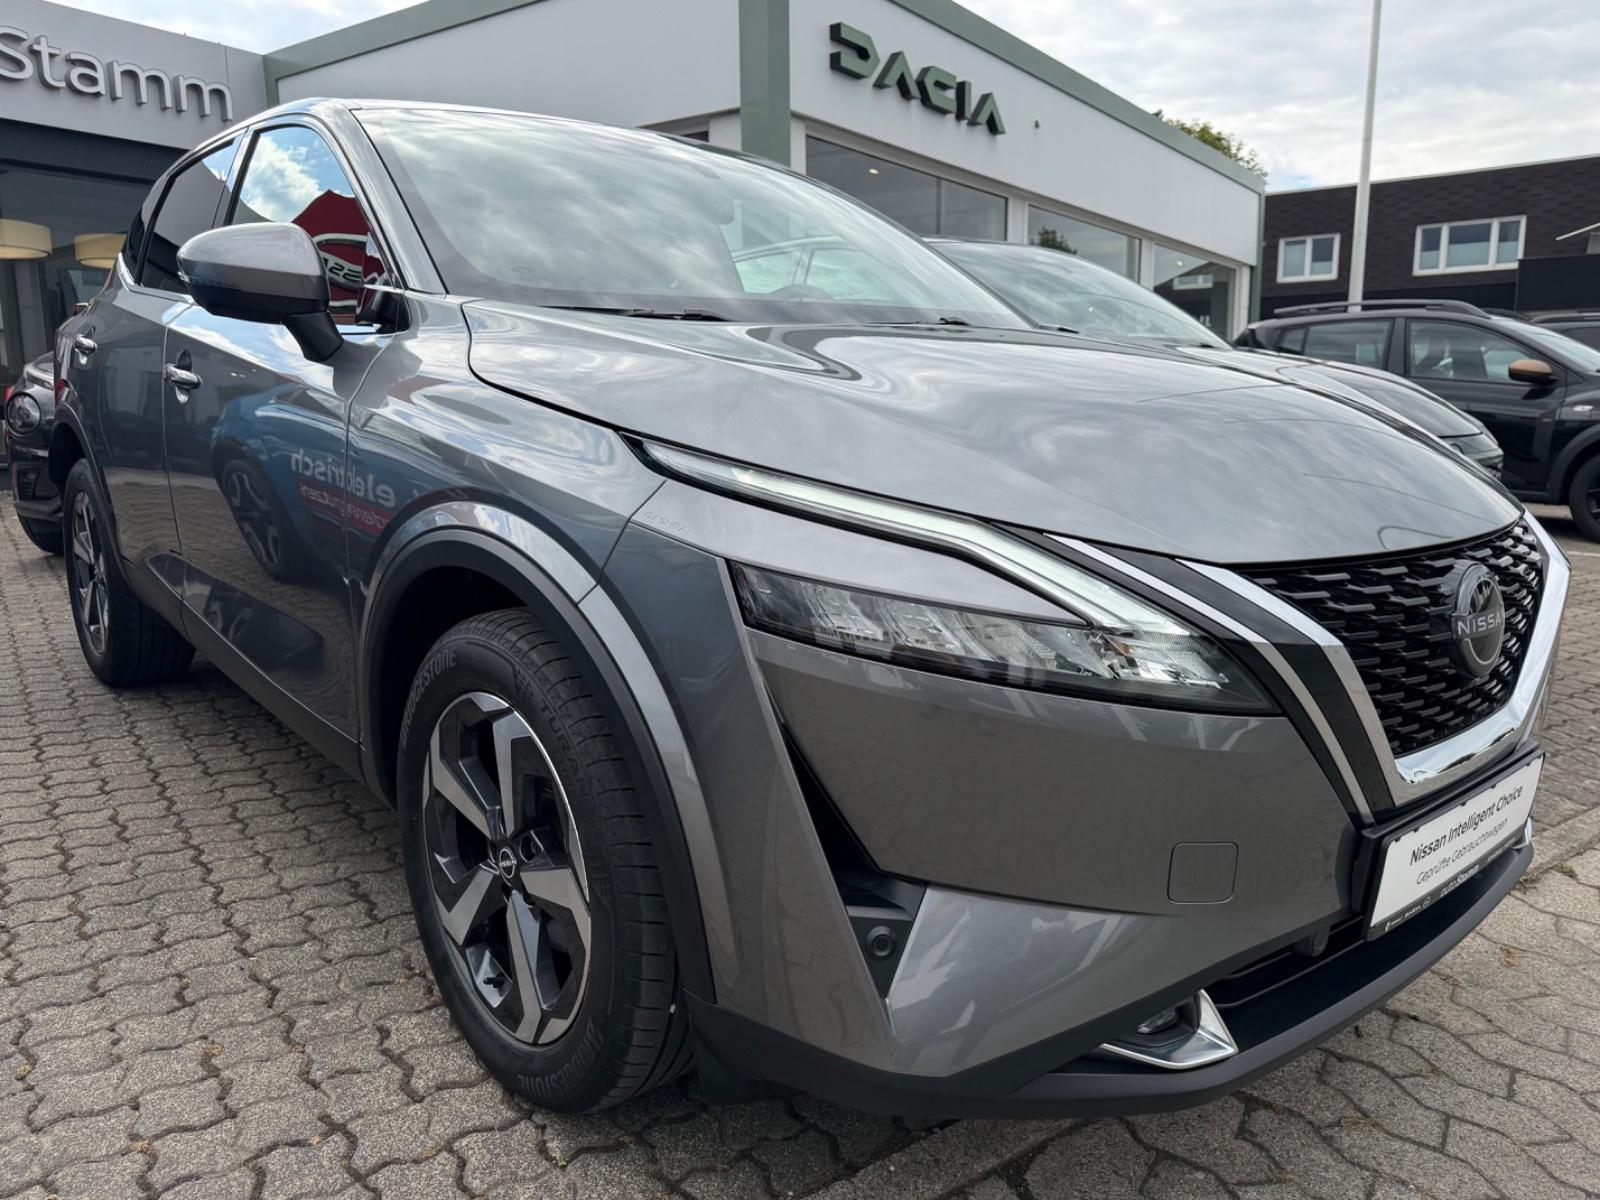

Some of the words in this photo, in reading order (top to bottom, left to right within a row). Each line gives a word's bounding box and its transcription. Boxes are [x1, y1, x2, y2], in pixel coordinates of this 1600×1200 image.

[0, 25, 234, 121] Stamm
[829, 22, 1006, 135] DACIA
[1457, 611, 1502, 635] NISSA
[1409, 834, 1447, 866] Nissan
[1448, 802, 1496, 843] Intelligent
[1496, 786, 1524, 812] Choice
